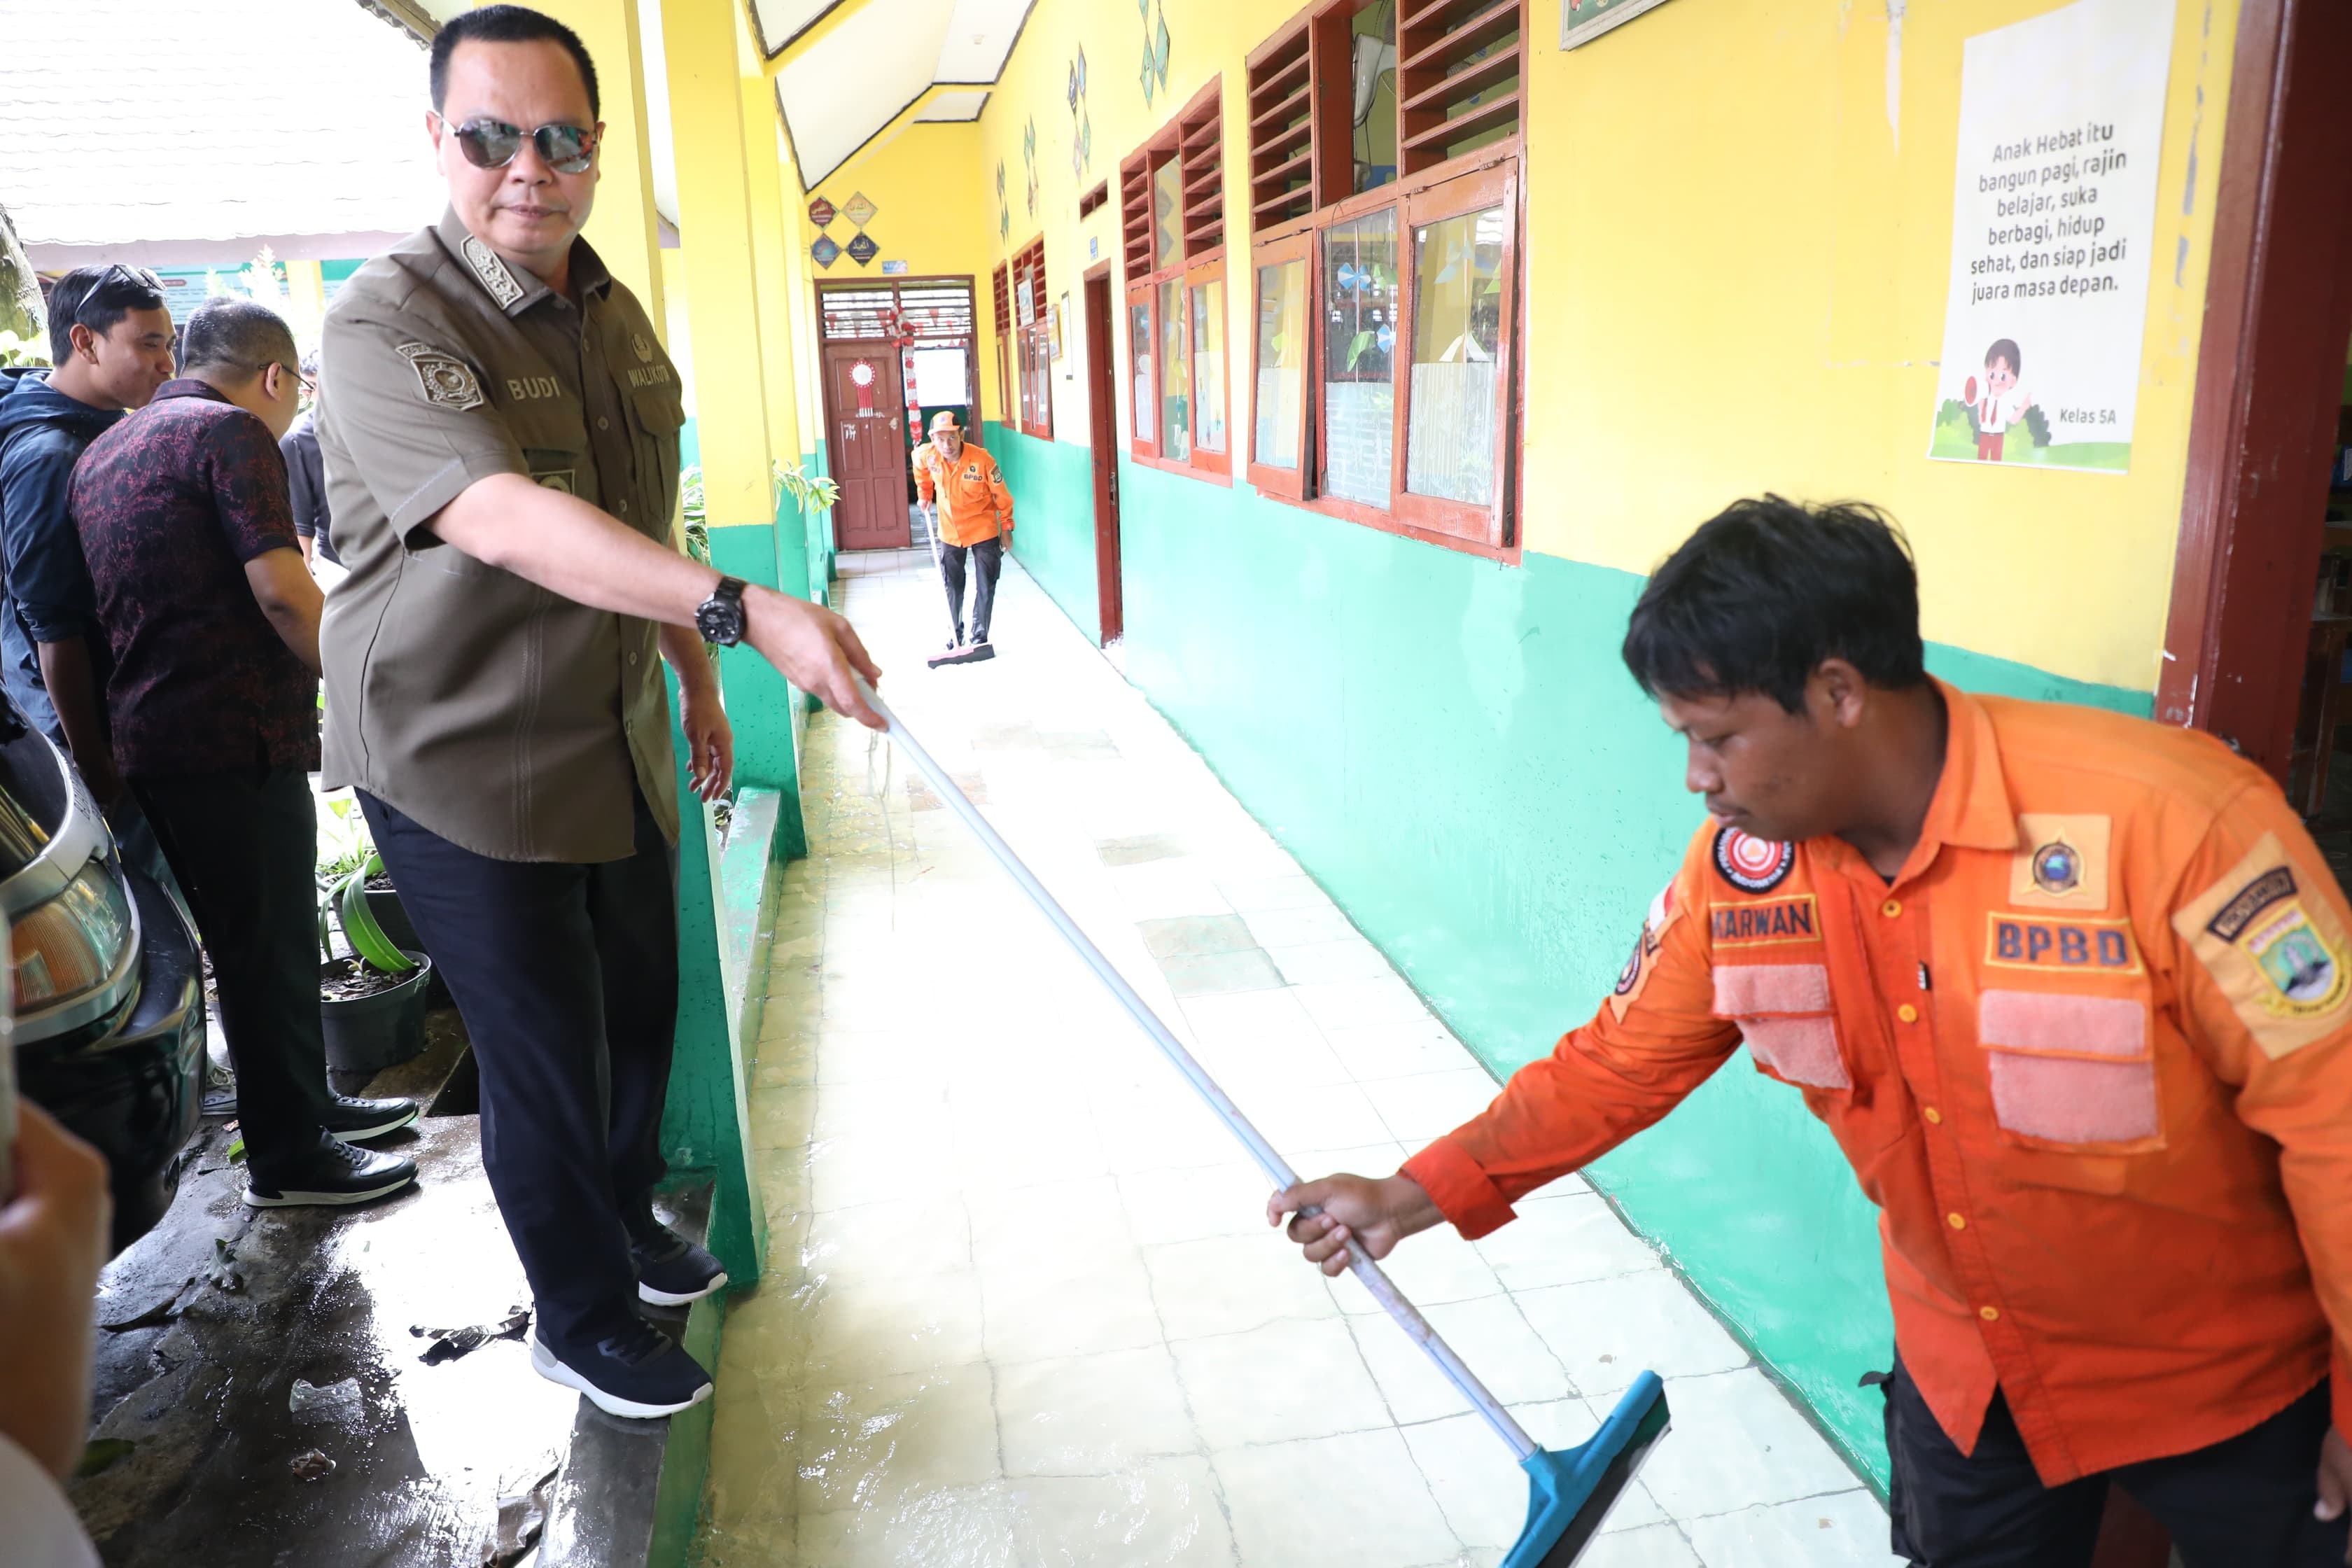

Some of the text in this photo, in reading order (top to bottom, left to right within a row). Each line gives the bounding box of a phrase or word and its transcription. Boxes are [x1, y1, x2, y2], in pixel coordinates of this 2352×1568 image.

[1992, 122, 2114, 163] Anak Hebat itu
[1979, 148, 2127, 192] bangun pagi, rajin
[1996, 186, 2098, 217] belajar, suka
[1988, 215, 2105, 246] berbagi, hidup
[1970, 238, 2127, 275] sehat, dan siap jadi
[1972, 274, 2119, 305] juara masa depan.
[507, 375, 561, 401] BUDI
[2059, 407, 2117, 425] Kelas 5A
[1997, 922, 2129, 966] BPBD
